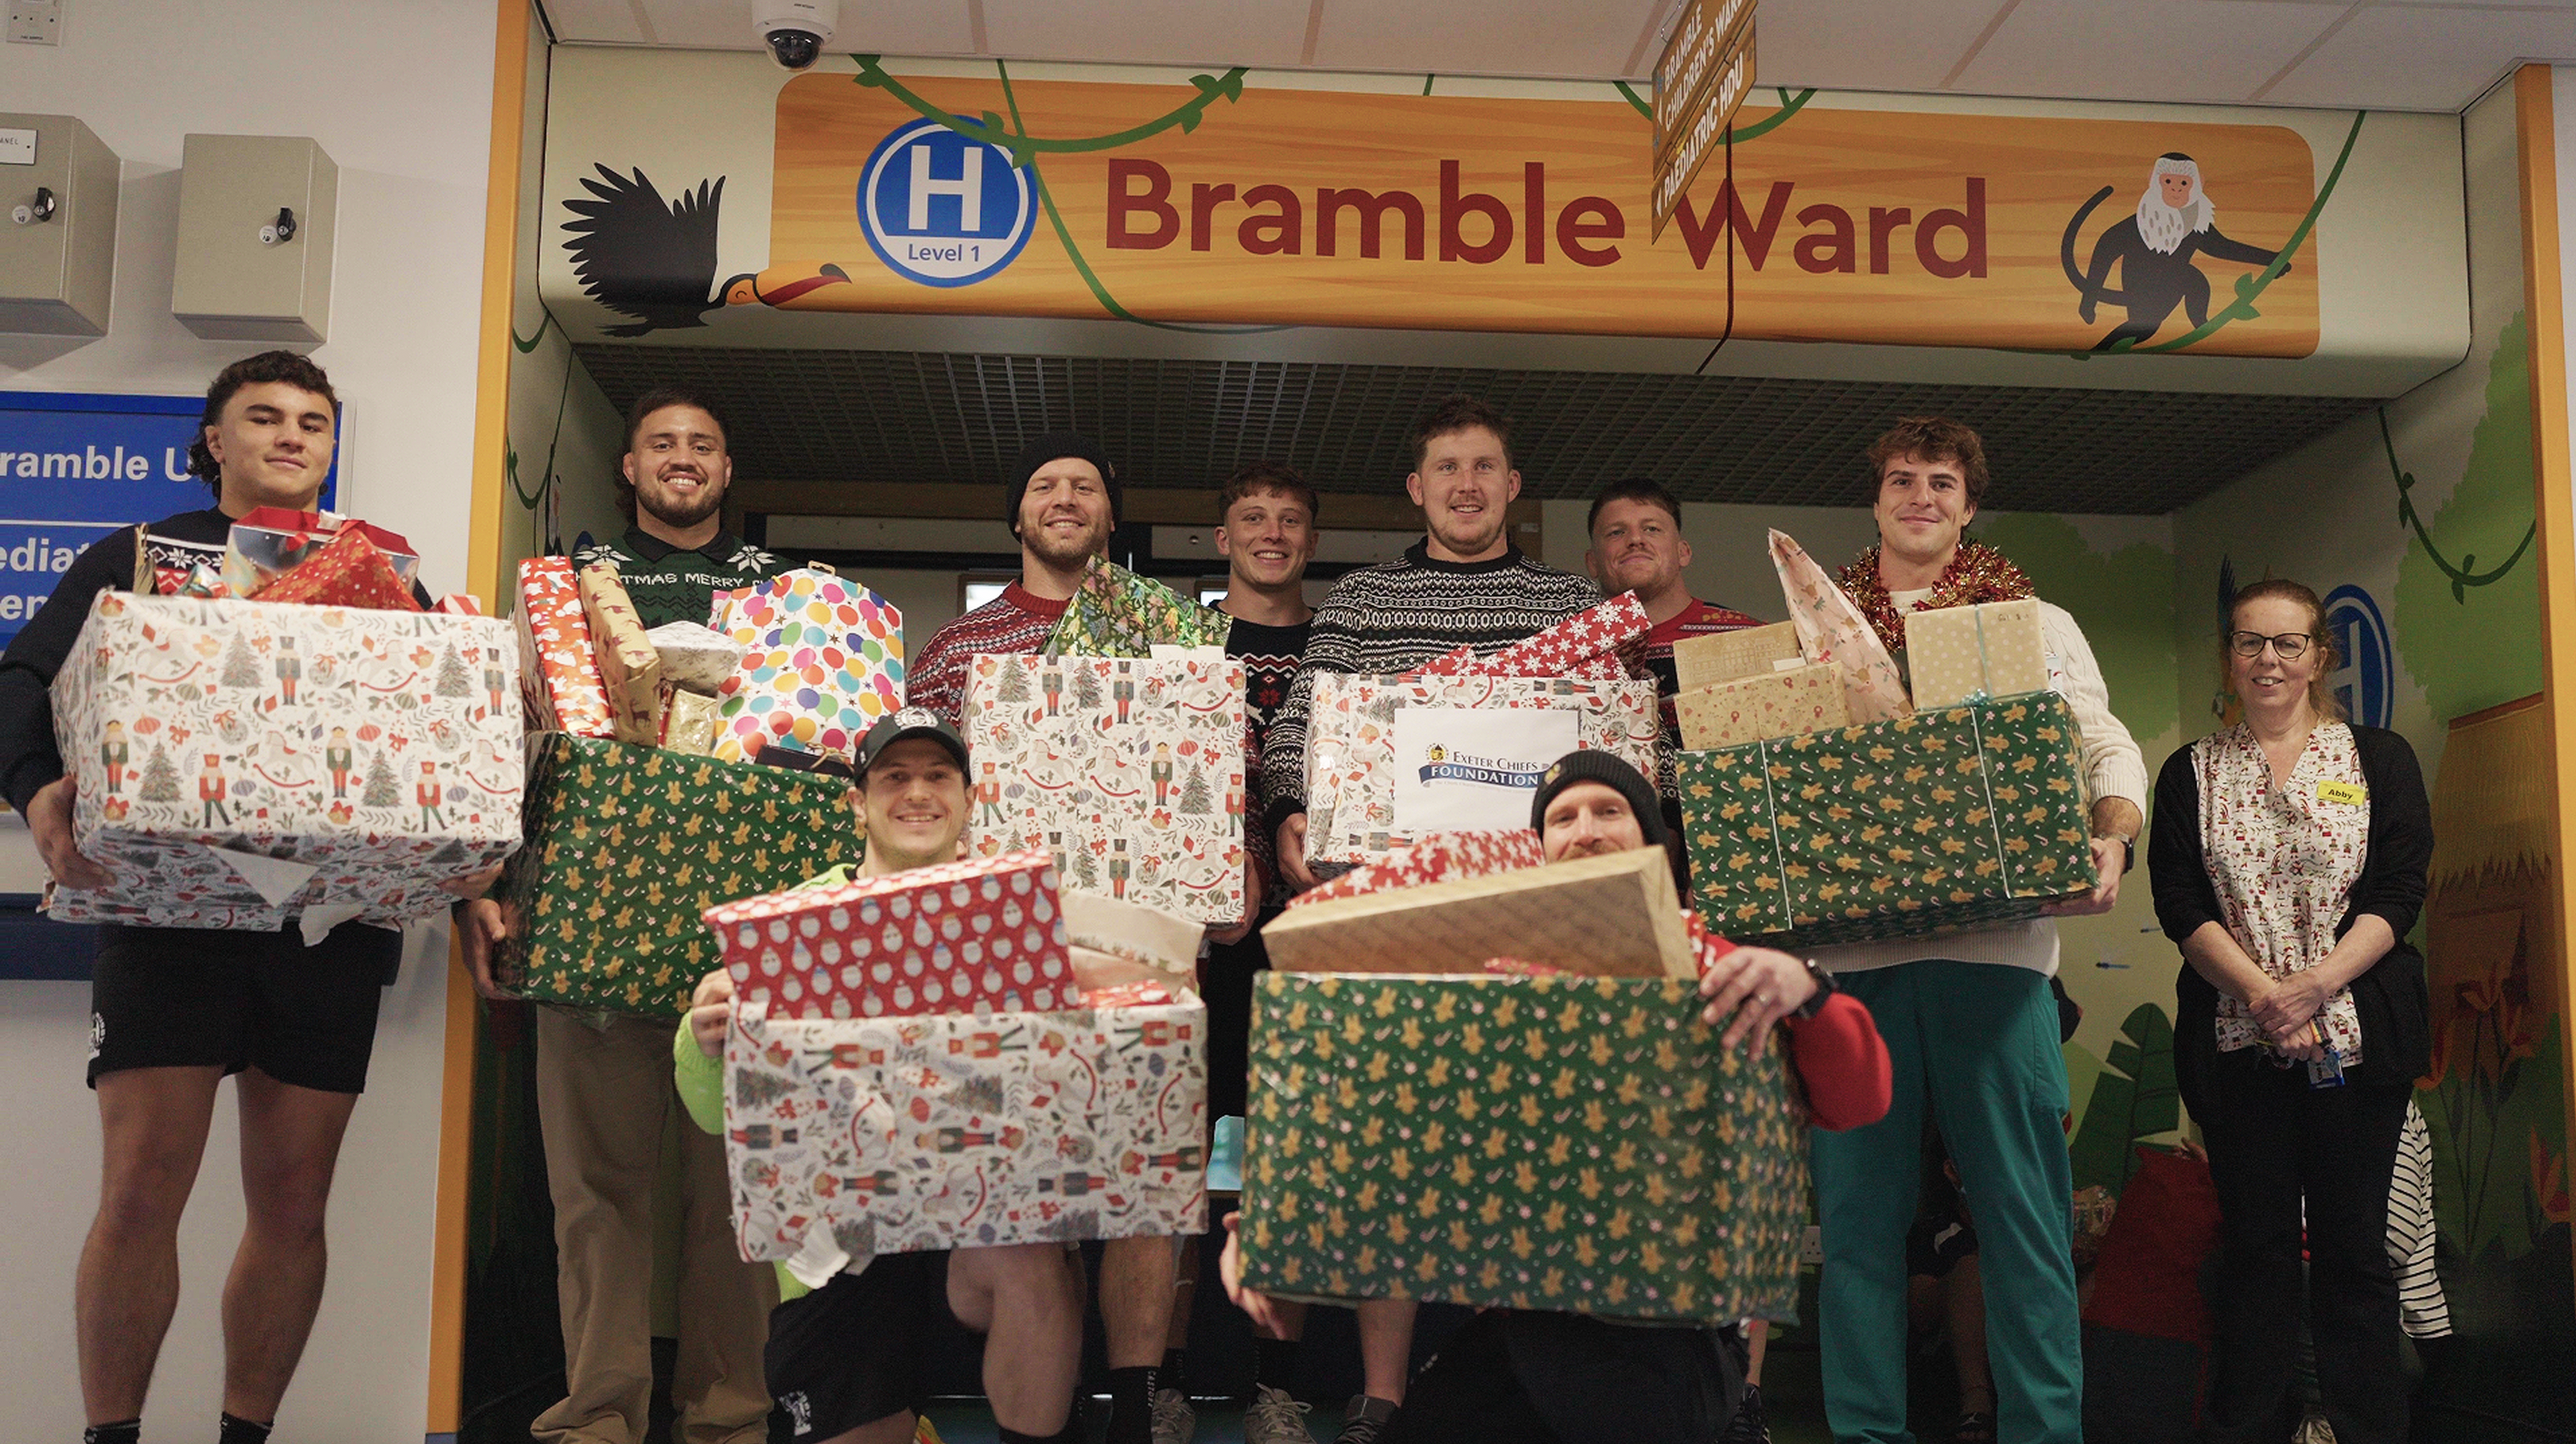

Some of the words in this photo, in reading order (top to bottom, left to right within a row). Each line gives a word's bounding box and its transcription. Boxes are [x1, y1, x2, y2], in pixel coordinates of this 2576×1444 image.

[1665, 3, 1702, 93] BRAMBLE
[1665, 27, 1715, 131] CHILDREN'S
[1664, 97, 1717, 208] PAEDIATRIC
[1720, 51, 1743, 118] HDU
[908, 145, 983, 231] H
[1106, 158, 1626, 267] Bramble
[1674, 177, 1988, 278] Ward
[908, 244, 962, 261] Level
[971, 245, 980, 262] 1
[684, 573, 744, 587] MERRY
[1432, 765, 1538, 786] FOUNDATION
[1453, 751, 1494, 768] EXETER
[1497, 757, 1538, 771] CHIEFS
[2327, 788, 2353, 801] Abby
